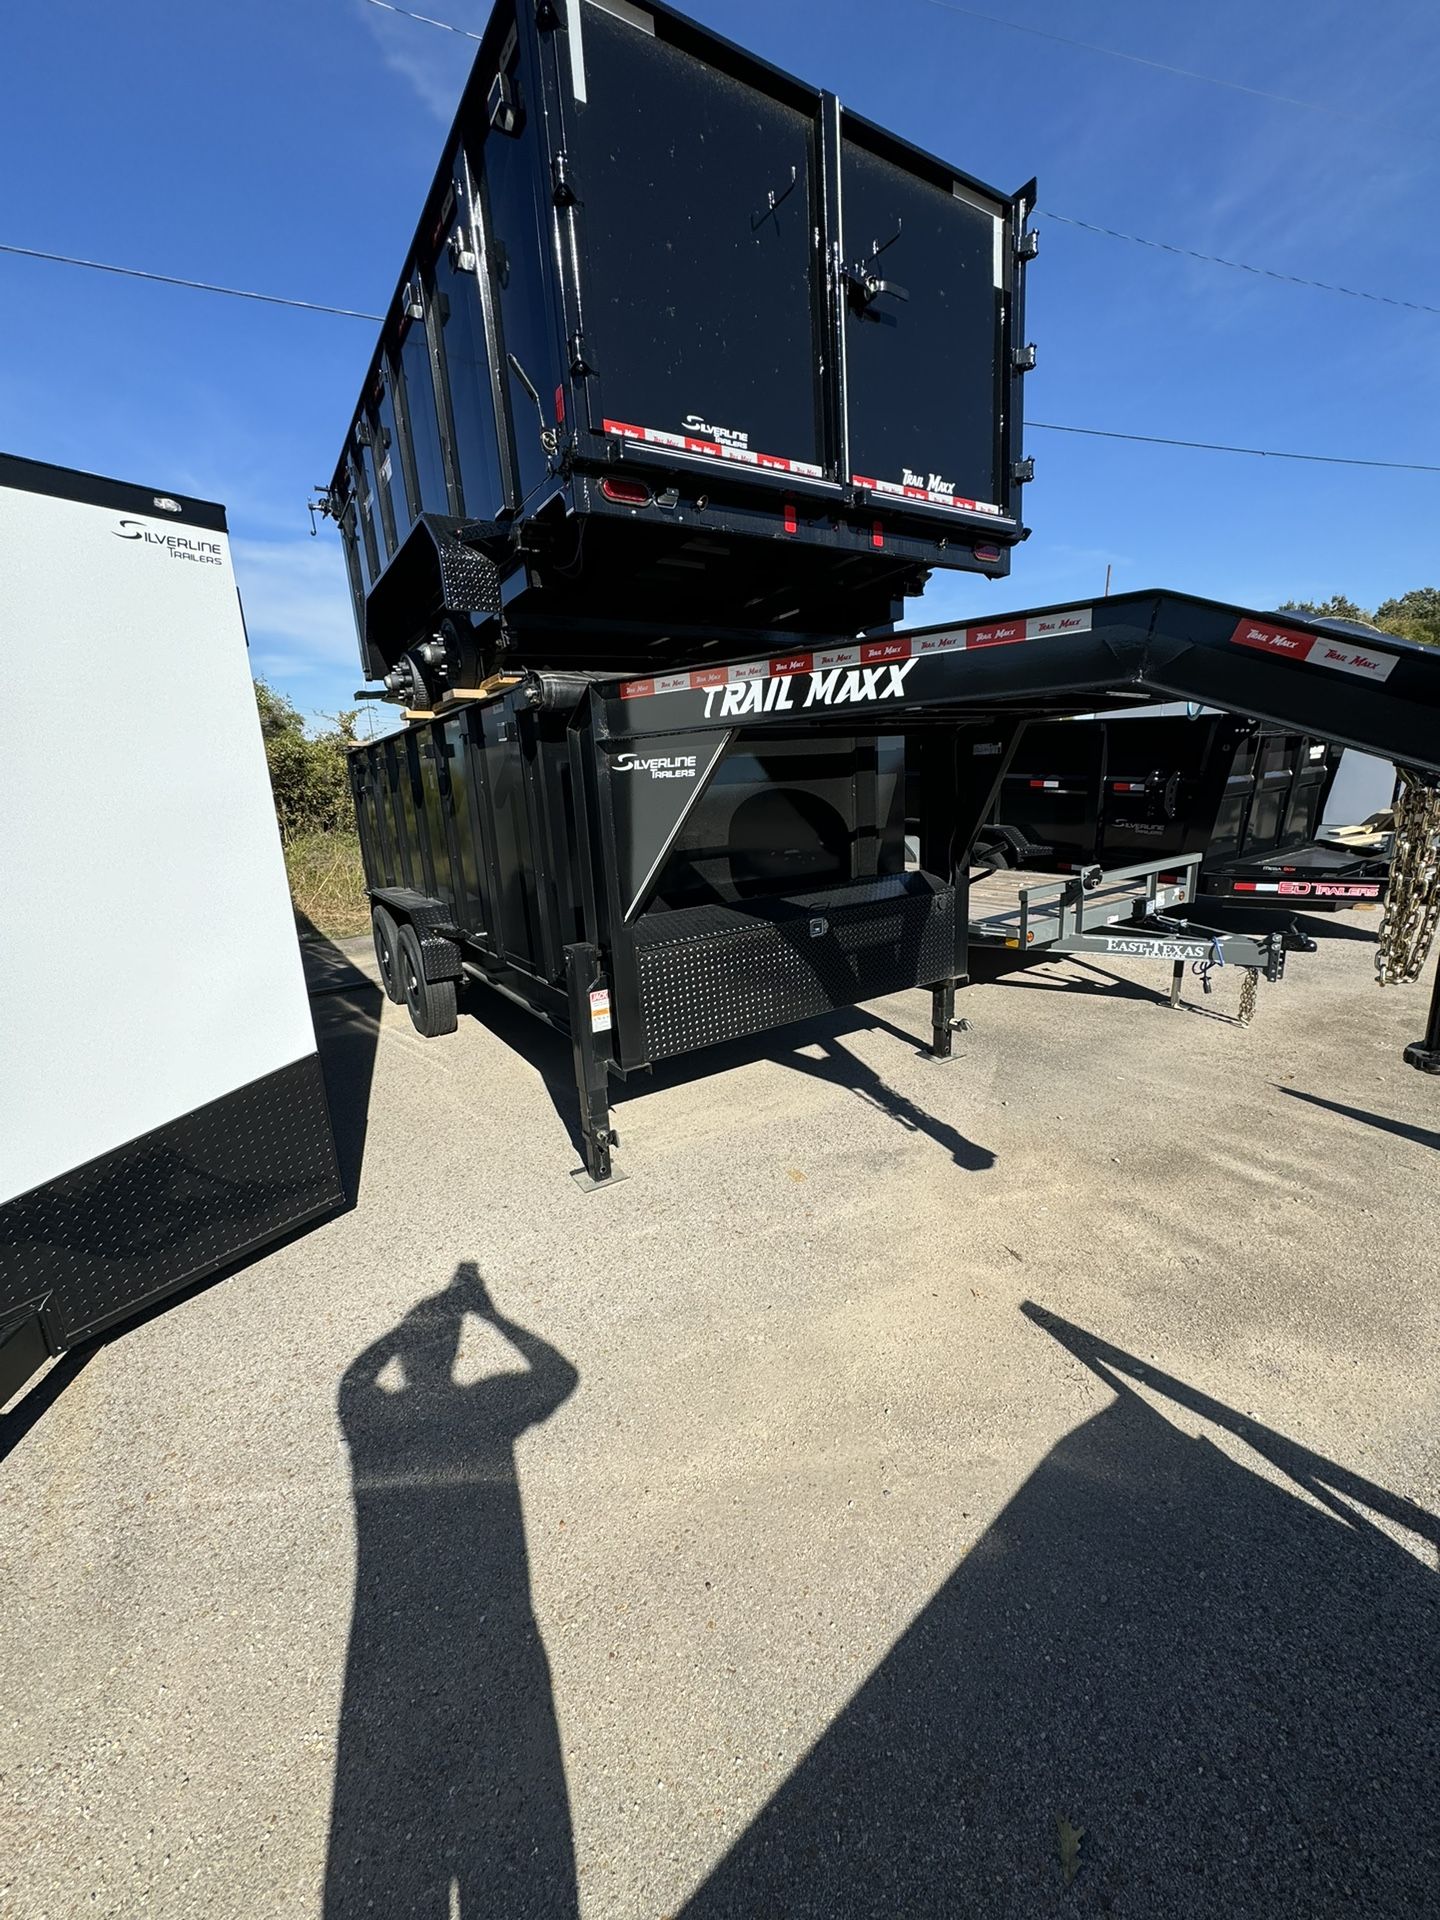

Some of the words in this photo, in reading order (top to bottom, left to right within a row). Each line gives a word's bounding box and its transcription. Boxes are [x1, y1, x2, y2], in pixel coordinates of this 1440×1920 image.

[681, 415, 748, 442] SILVERLINE
[902, 468, 924, 488] TRAIL
[926, 473, 955, 494] MAXX
[111, 520, 222, 555] SILVERLINE
[167, 546, 222, 566] TRAILERS
[1246, 628, 1269, 643] TRAIL
[1270, 634, 1299, 649] MAXX
[1324, 648, 1348, 662] TRAIL
[1349, 655, 1380, 670] MAXX
[702, 675, 794, 718] TRAIL
[802, 658, 920, 708] MAXX
[611, 753, 697, 771] SILVERLINE
[650, 768, 696, 779] TRAILERS
[1312, 882, 1380, 897] TRAILERS
[1106, 939, 1147, 953] EAST
[1150, 939, 1205, 957] TEXAS
